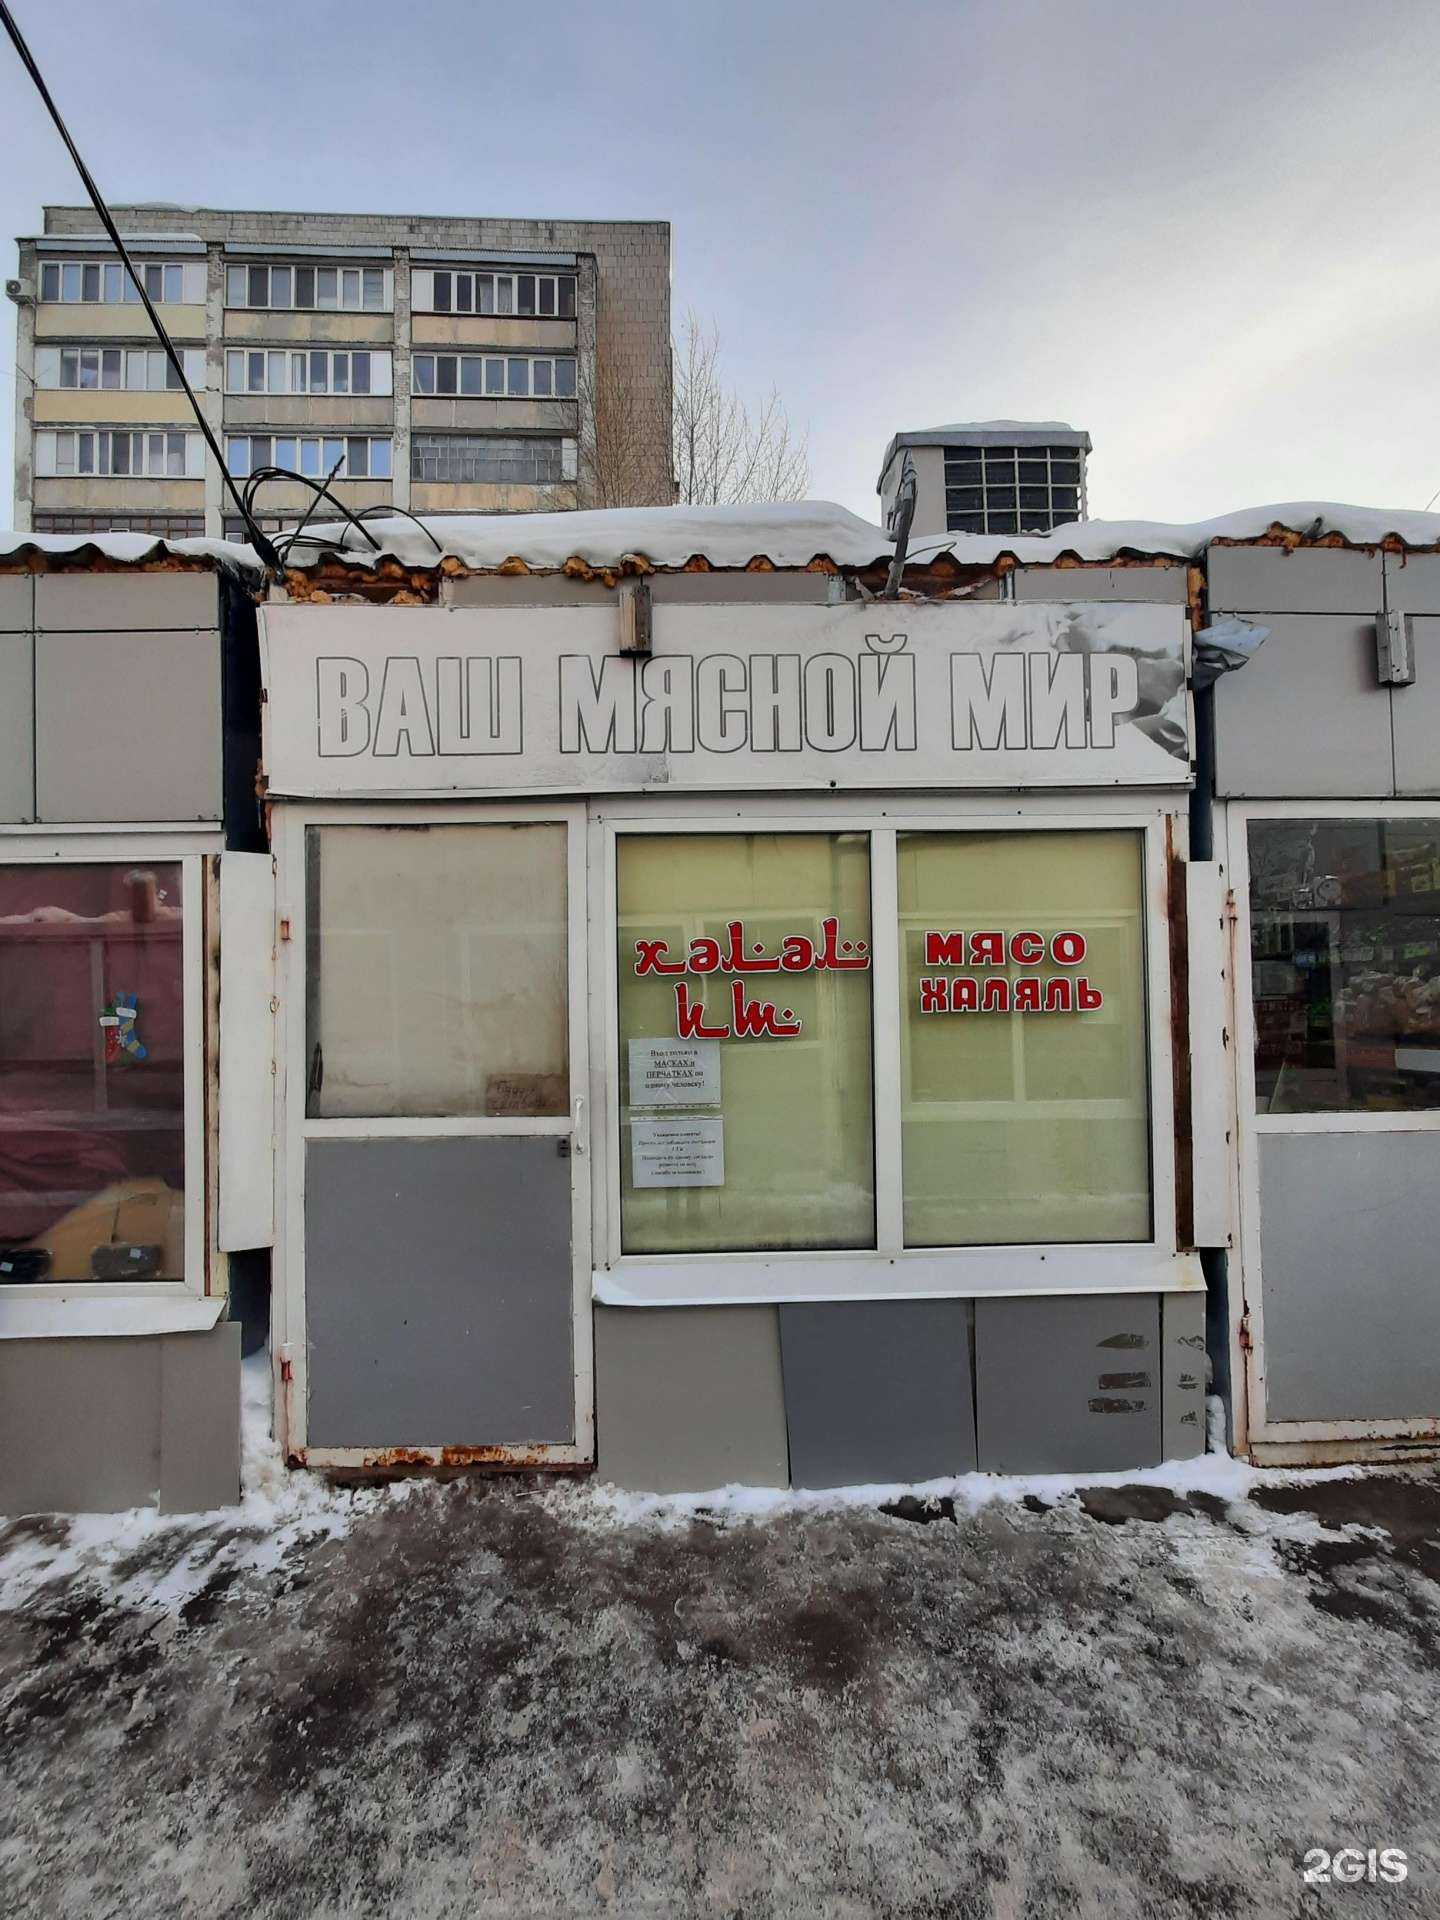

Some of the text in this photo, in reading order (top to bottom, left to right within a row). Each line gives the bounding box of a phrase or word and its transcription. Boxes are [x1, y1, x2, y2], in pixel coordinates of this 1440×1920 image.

[316, 634, 1140, 757] ВАШ МЯСНОЙ МИР
[924, 930, 1088, 966] МЯСО
[919, 976, 1104, 1014] ХАЛЯЛЬ
